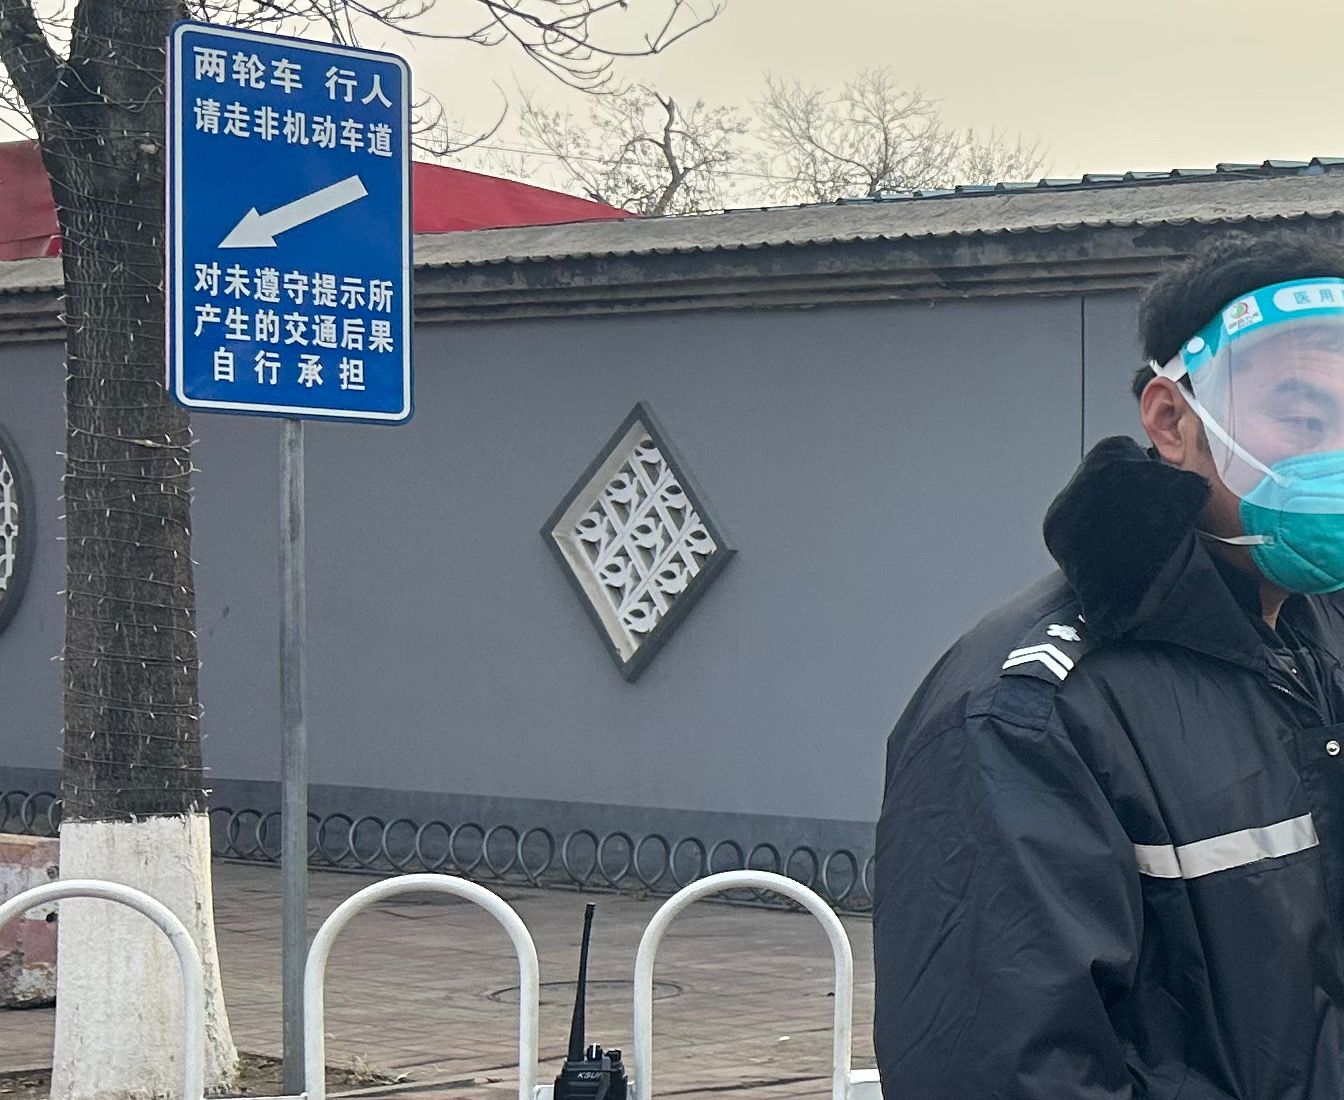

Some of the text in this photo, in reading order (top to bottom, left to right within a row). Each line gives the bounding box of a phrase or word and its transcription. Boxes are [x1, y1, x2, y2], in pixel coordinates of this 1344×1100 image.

[193, 46, 393, 108] 两轮车 行人
[194, 98, 393, 157] 请走非机动车道
[193, 262, 393, 313] 对未遵守提示所
[193, 304, 394, 353] 产生的交通后果
[212, 346, 366, 391] 自行承担
